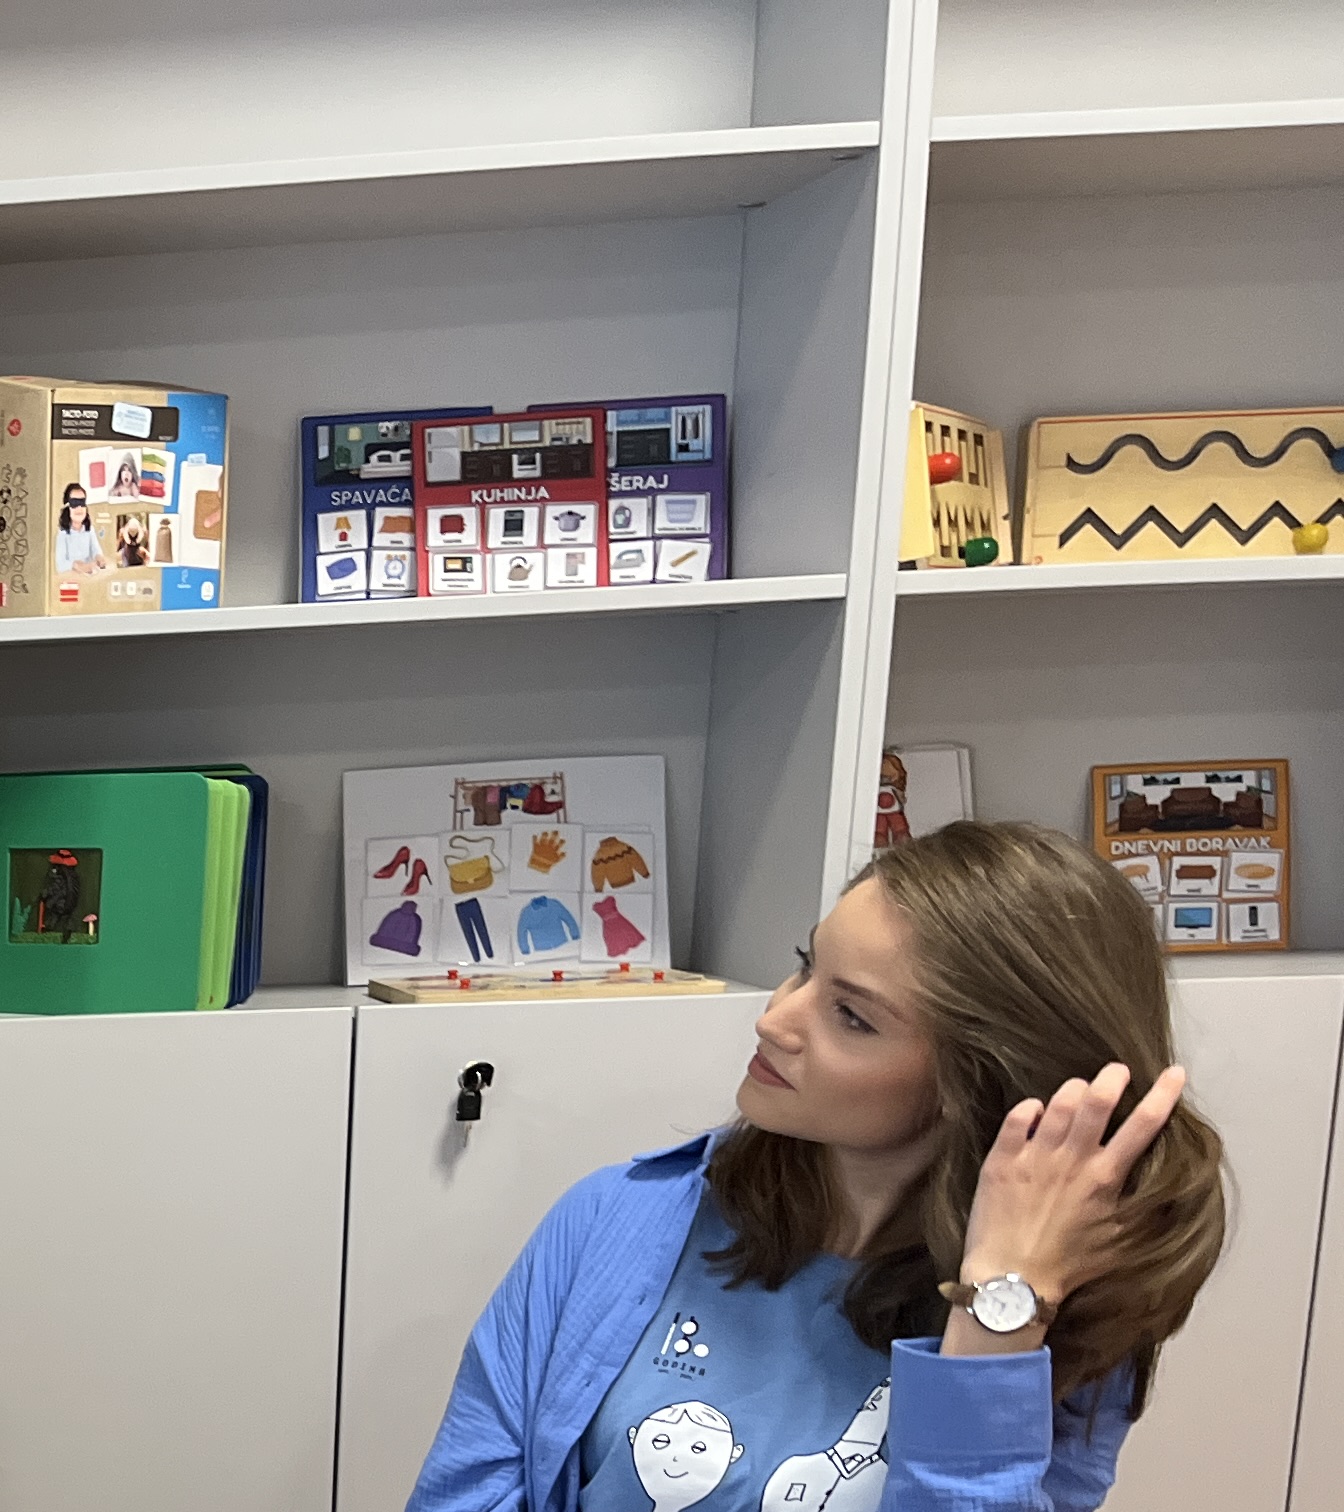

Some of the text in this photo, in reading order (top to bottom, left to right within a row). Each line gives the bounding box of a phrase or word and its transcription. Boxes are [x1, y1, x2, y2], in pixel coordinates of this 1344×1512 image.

[471, 486, 550, 504] KUHINJA
[1112, 836, 1271, 855] DNEVNI BORAVAK
